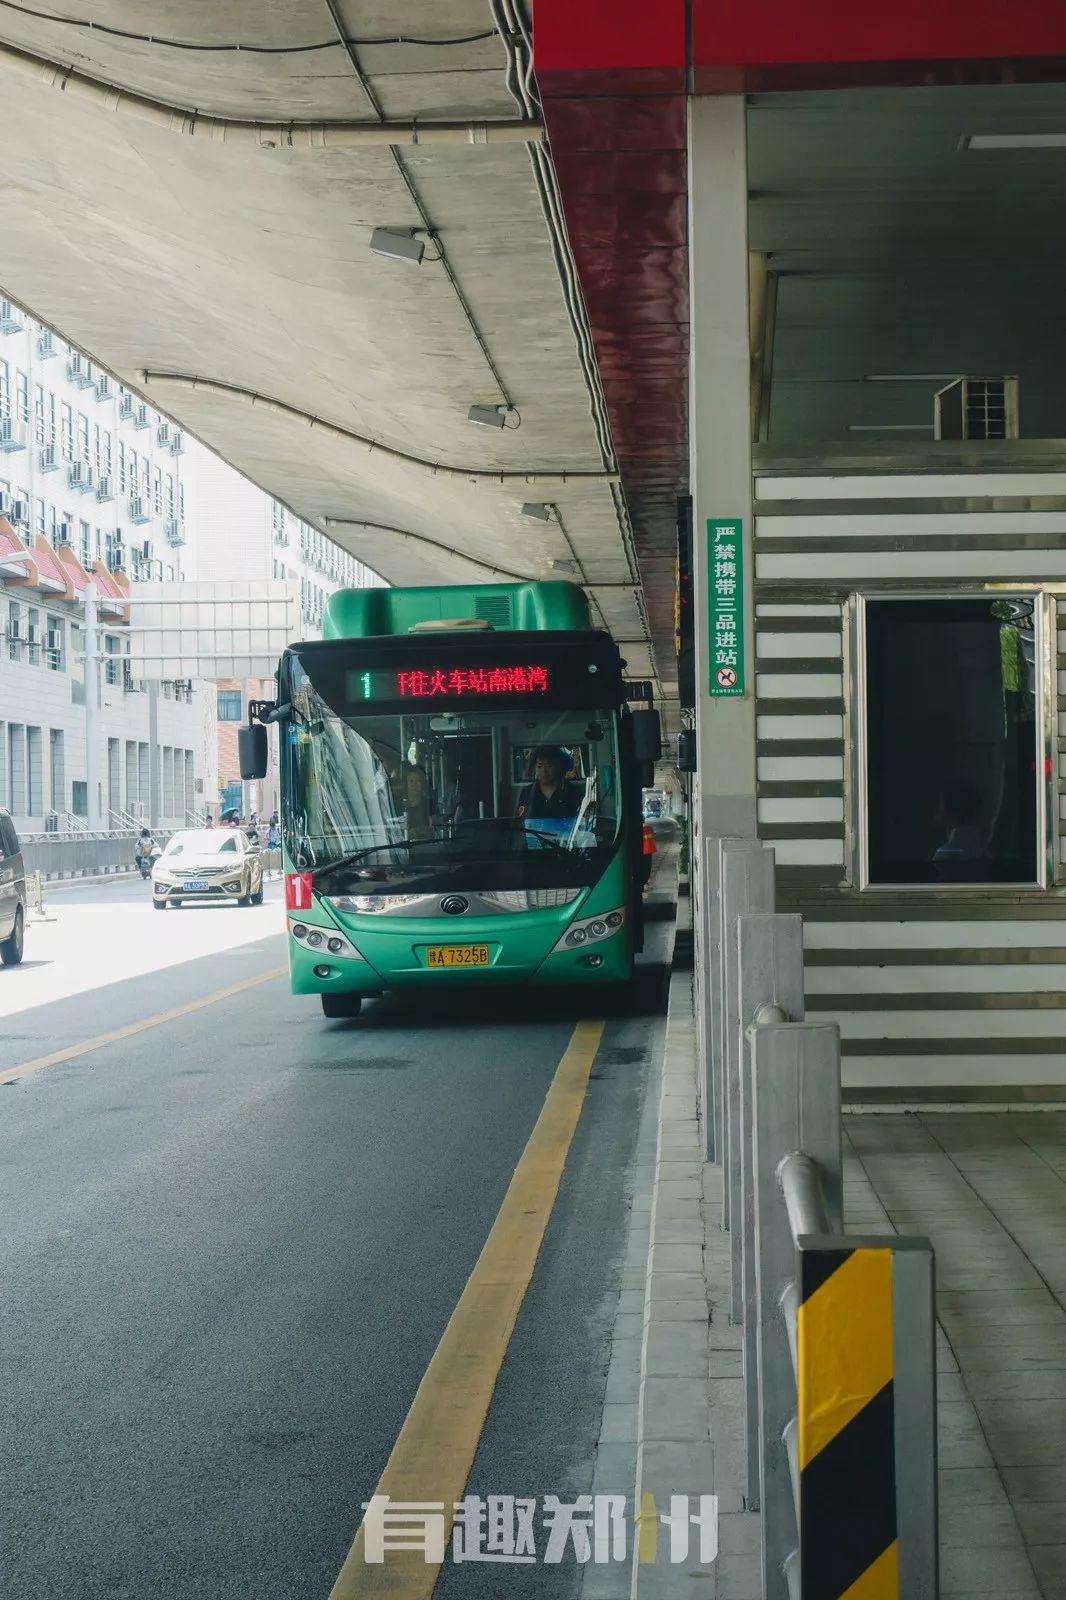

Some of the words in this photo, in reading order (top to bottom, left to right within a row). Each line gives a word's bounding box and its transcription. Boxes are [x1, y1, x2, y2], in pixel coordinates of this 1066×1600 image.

[714, 526, 737, 665] 严禁携带三品进站
[361, 672, 371, 698] 1
[291, 876, 302, 907] 1
